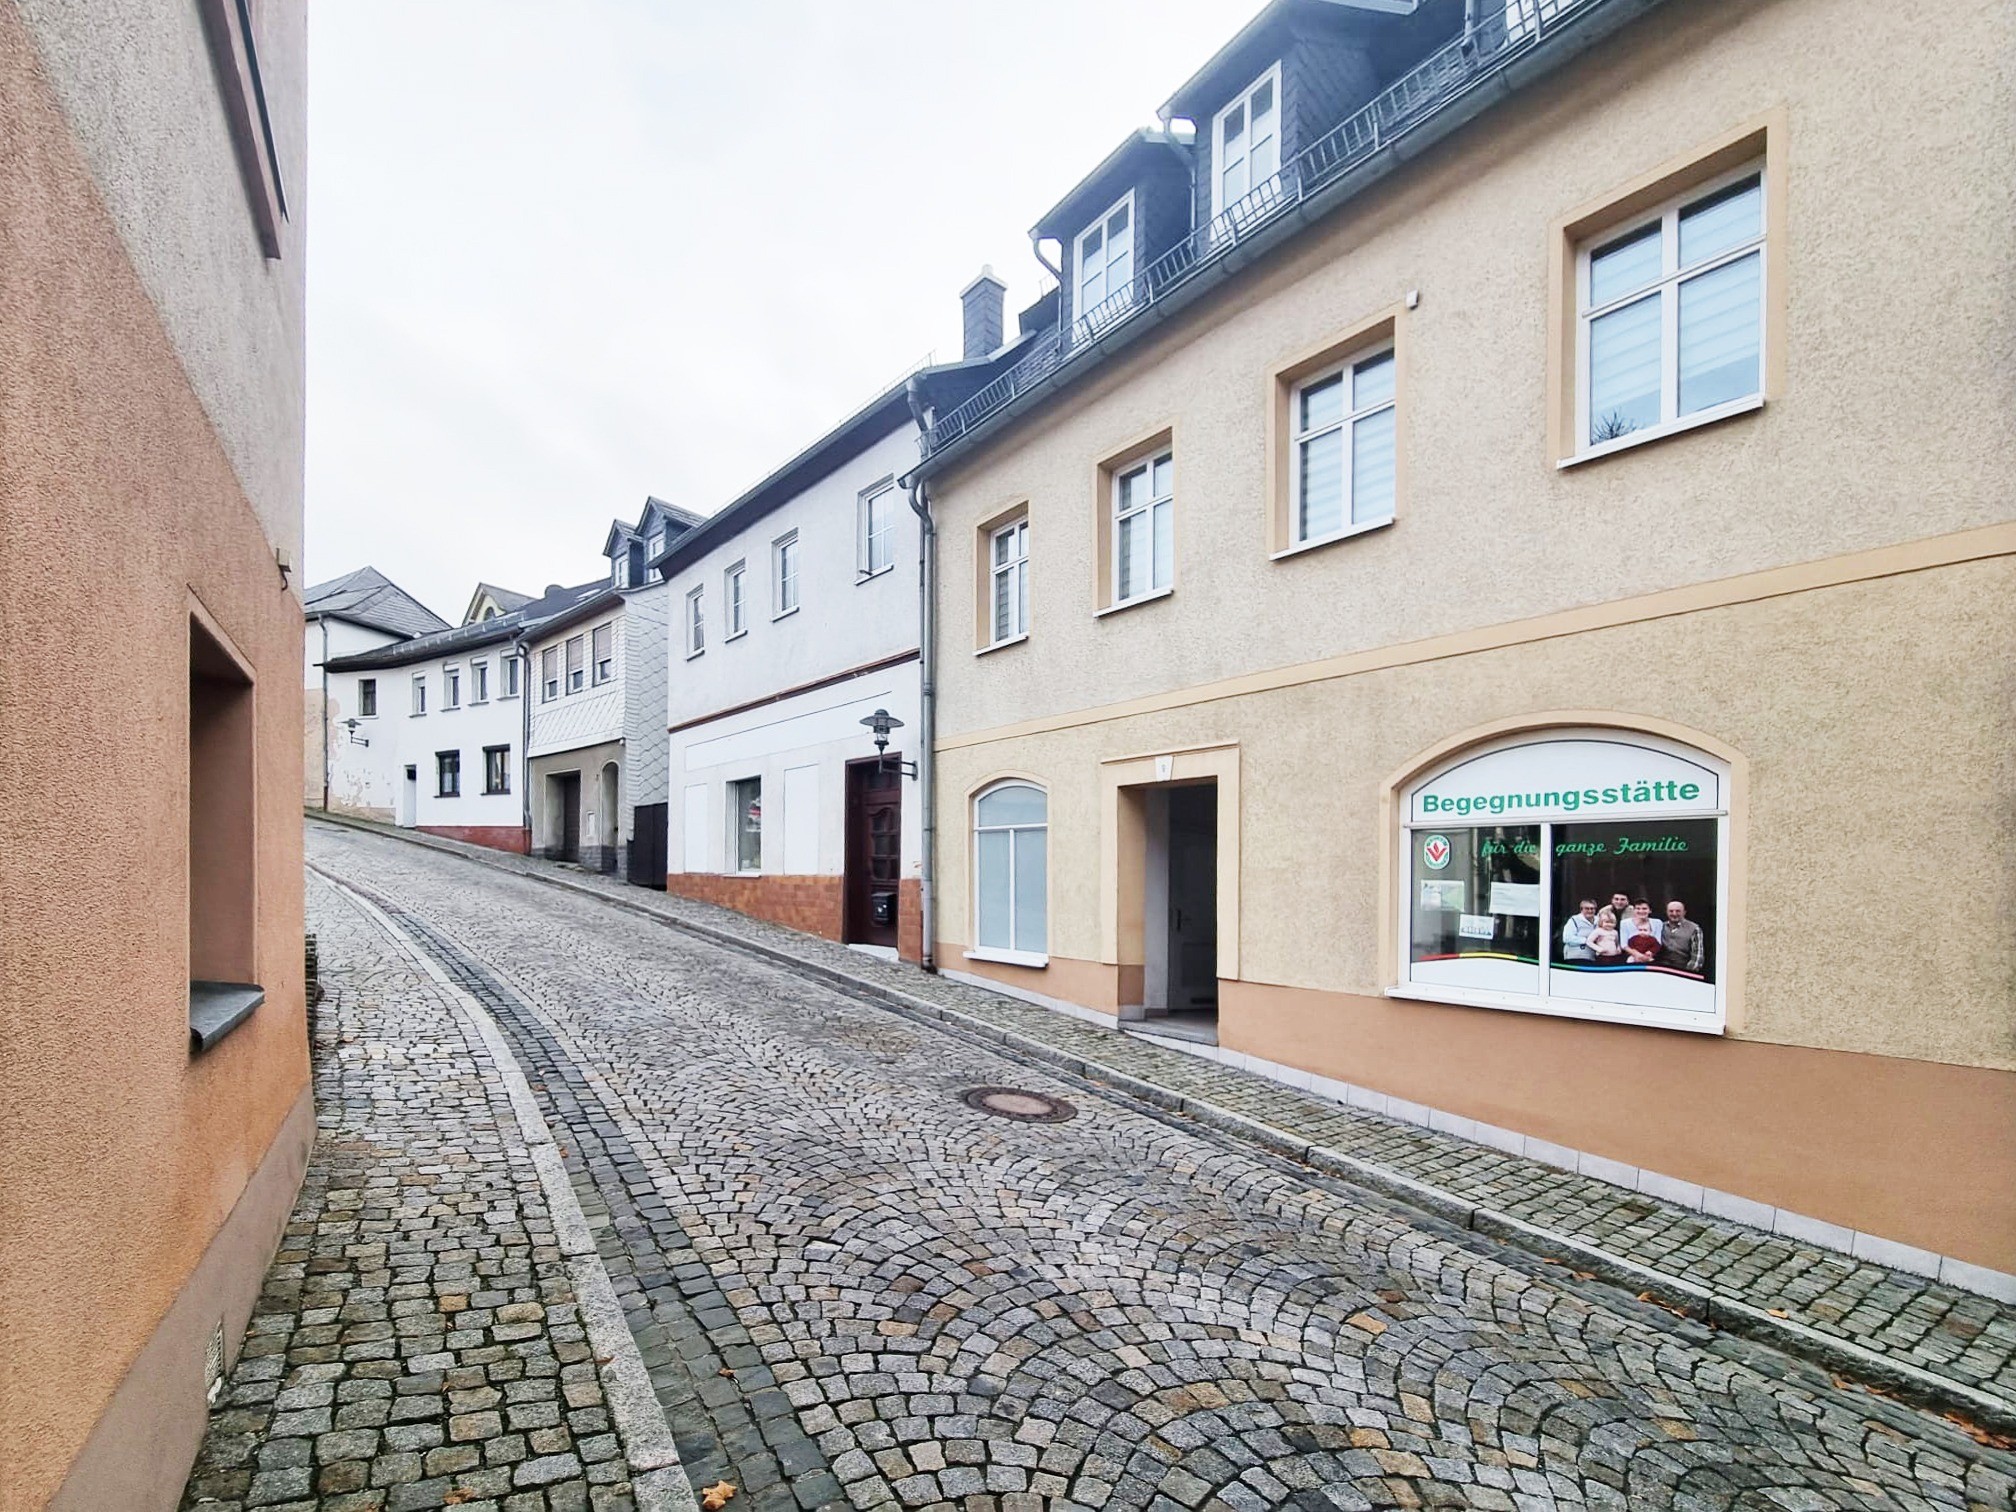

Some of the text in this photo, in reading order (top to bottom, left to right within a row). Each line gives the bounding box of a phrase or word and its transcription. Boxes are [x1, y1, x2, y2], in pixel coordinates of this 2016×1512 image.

[1423, 780, 1700, 816] Begegnungsstätte
[1481, 836, 1689, 857] für die ganze Familie
